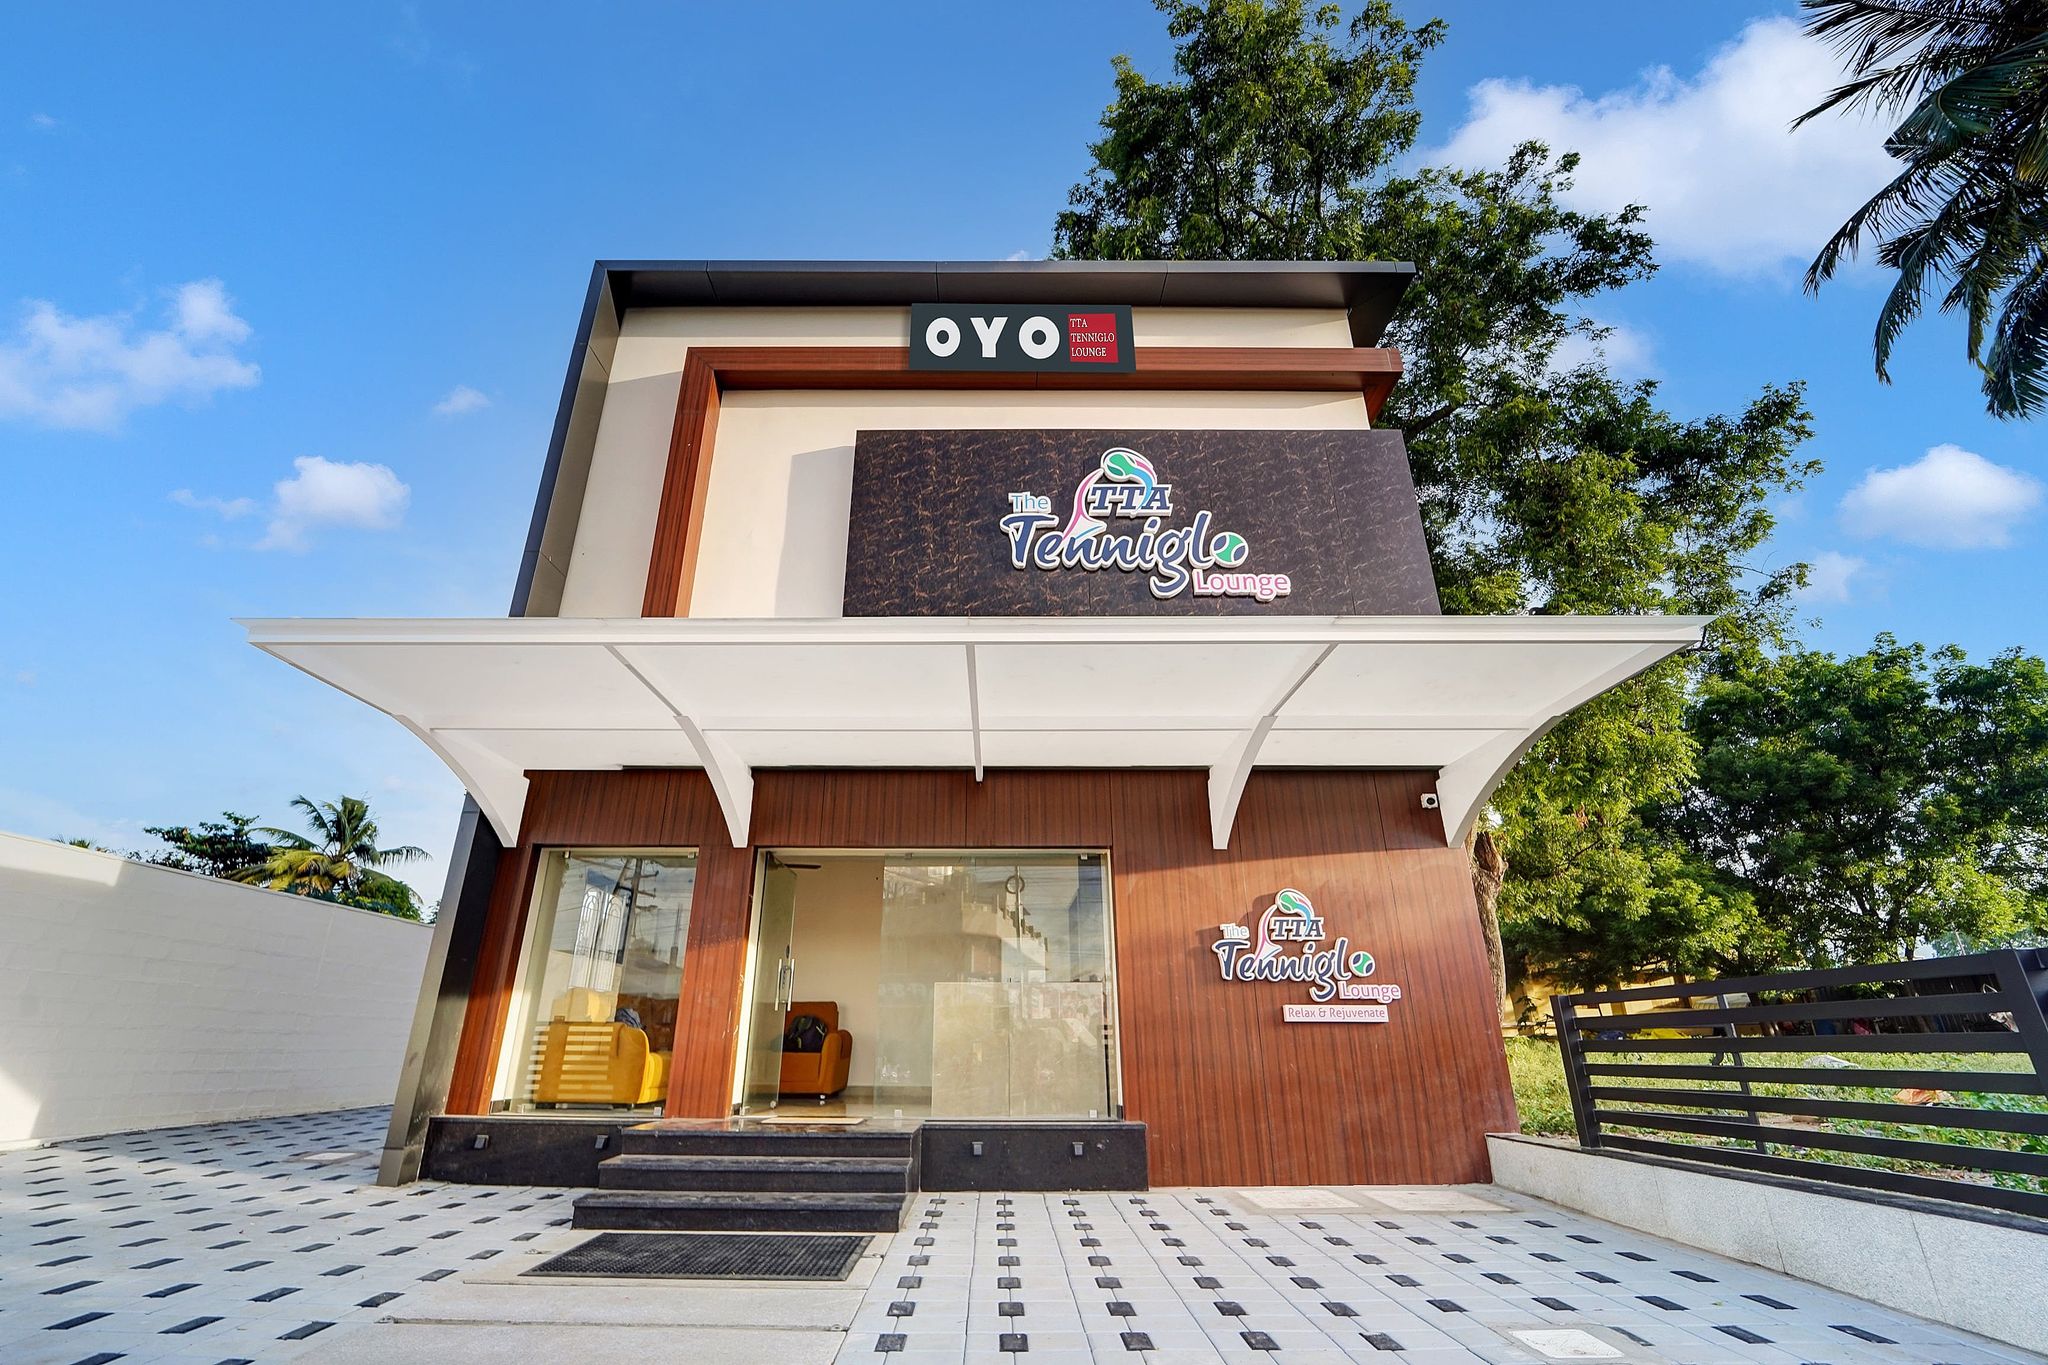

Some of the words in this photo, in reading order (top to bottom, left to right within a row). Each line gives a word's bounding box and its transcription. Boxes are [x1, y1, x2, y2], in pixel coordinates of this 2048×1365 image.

[1069, 318, 1088, 328] TTA
[925, 316, 1060, 359] OYO
[1070, 332, 1115, 343] TENNIGLO
[1071, 346, 1107, 357] LOUNGE
[1010, 493, 1049, 513] The
[1089, 484, 1171, 512] TTA
[1195, 570, 1290, 600] Lounge
[1222, 924, 1249, 938] The
[1272, 919, 1324, 938] TTA
[1340, 983, 1401, 1002] Lounge
[1288, 1007, 1316, 1018] Relax
[1318, 1008, 1327, 1018] &
[1329, 1007, 1385, 1020] Rejuvenate
